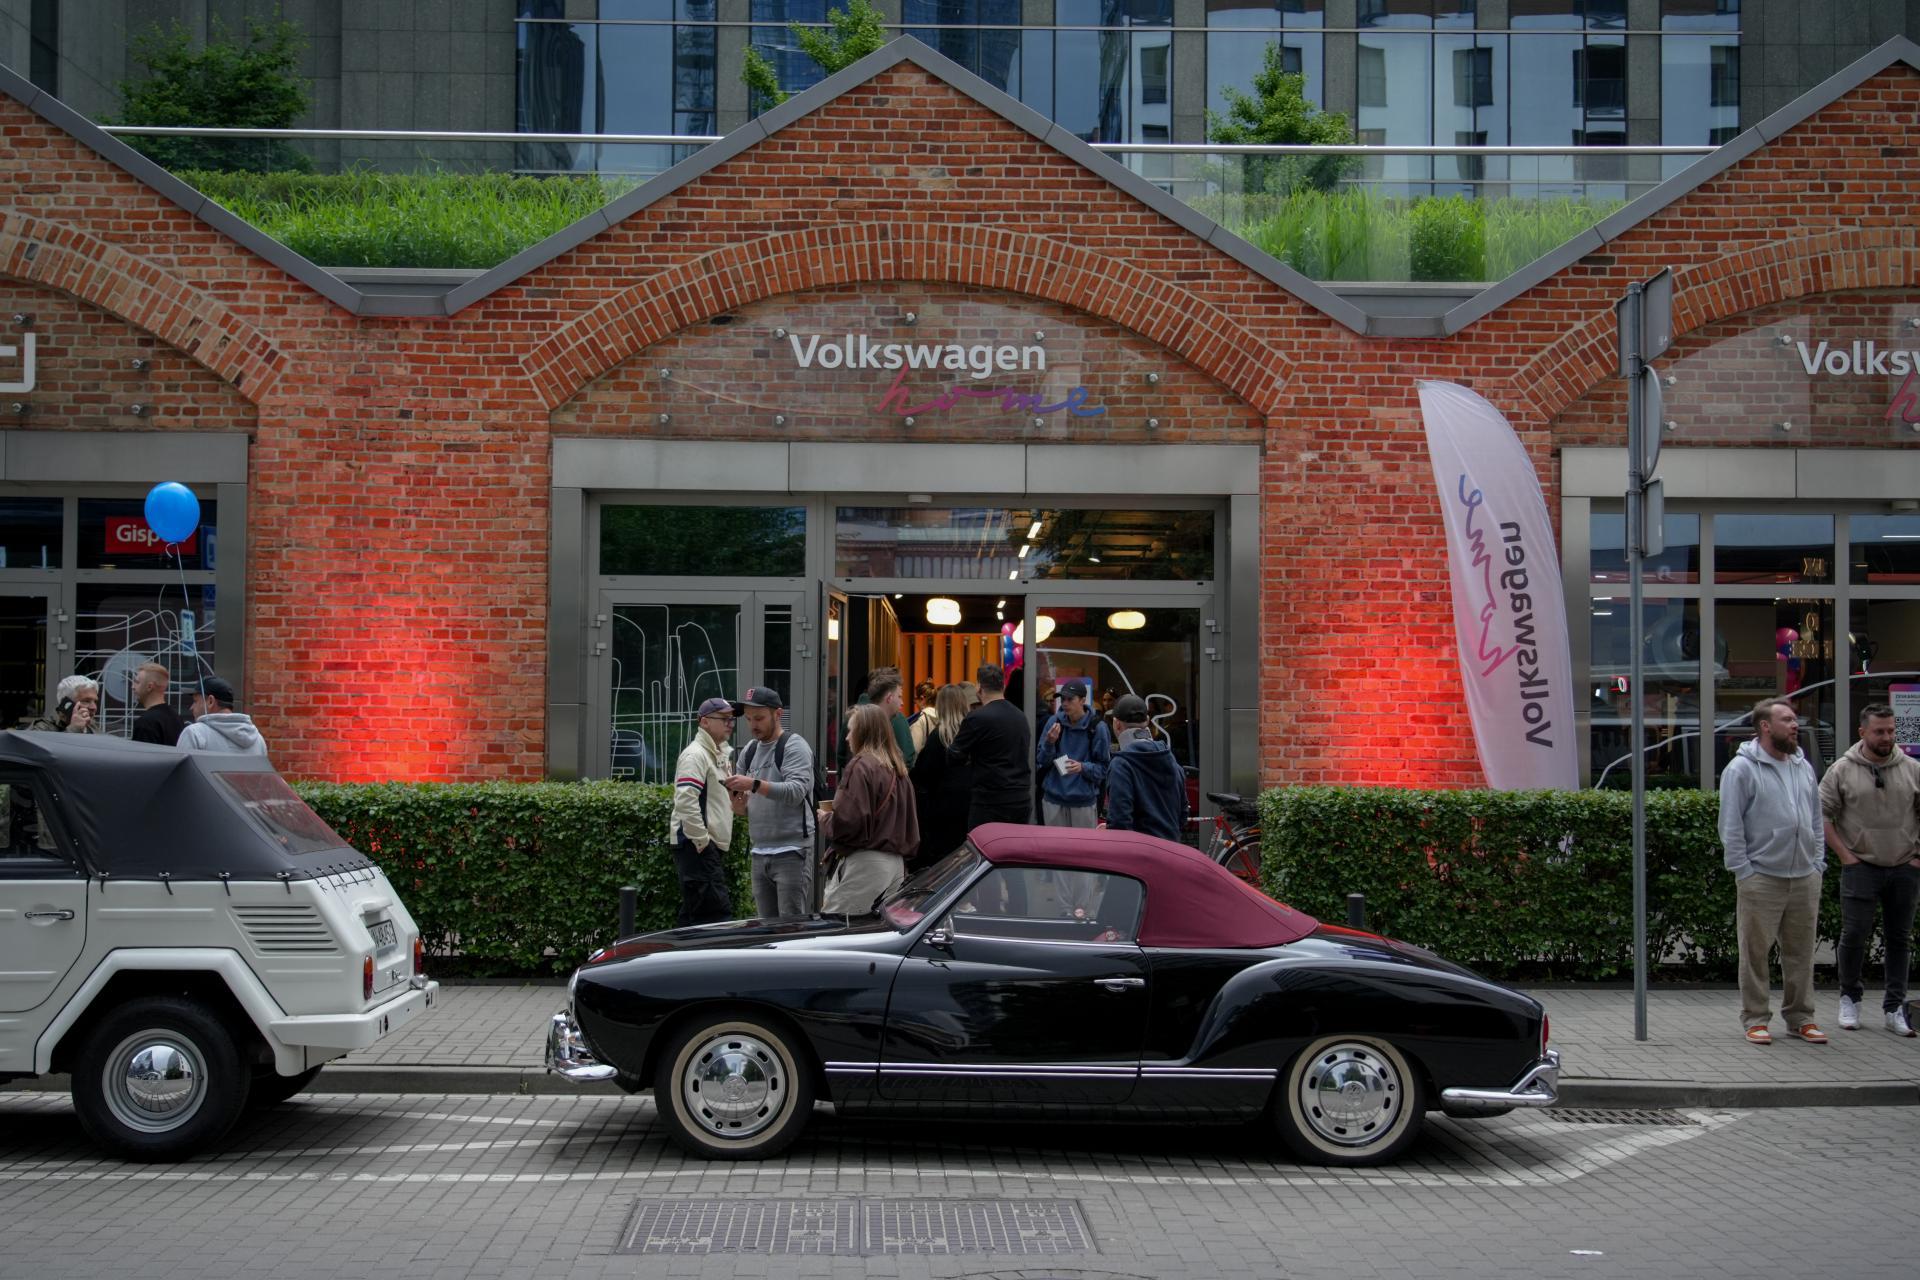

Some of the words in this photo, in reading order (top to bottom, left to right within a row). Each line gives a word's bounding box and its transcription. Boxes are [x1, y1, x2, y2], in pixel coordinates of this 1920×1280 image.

[789, 334, 1045, 379] Volkswagen
[874, 365, 1105, 417] home
[116, 524, 186, 547] Gisp
